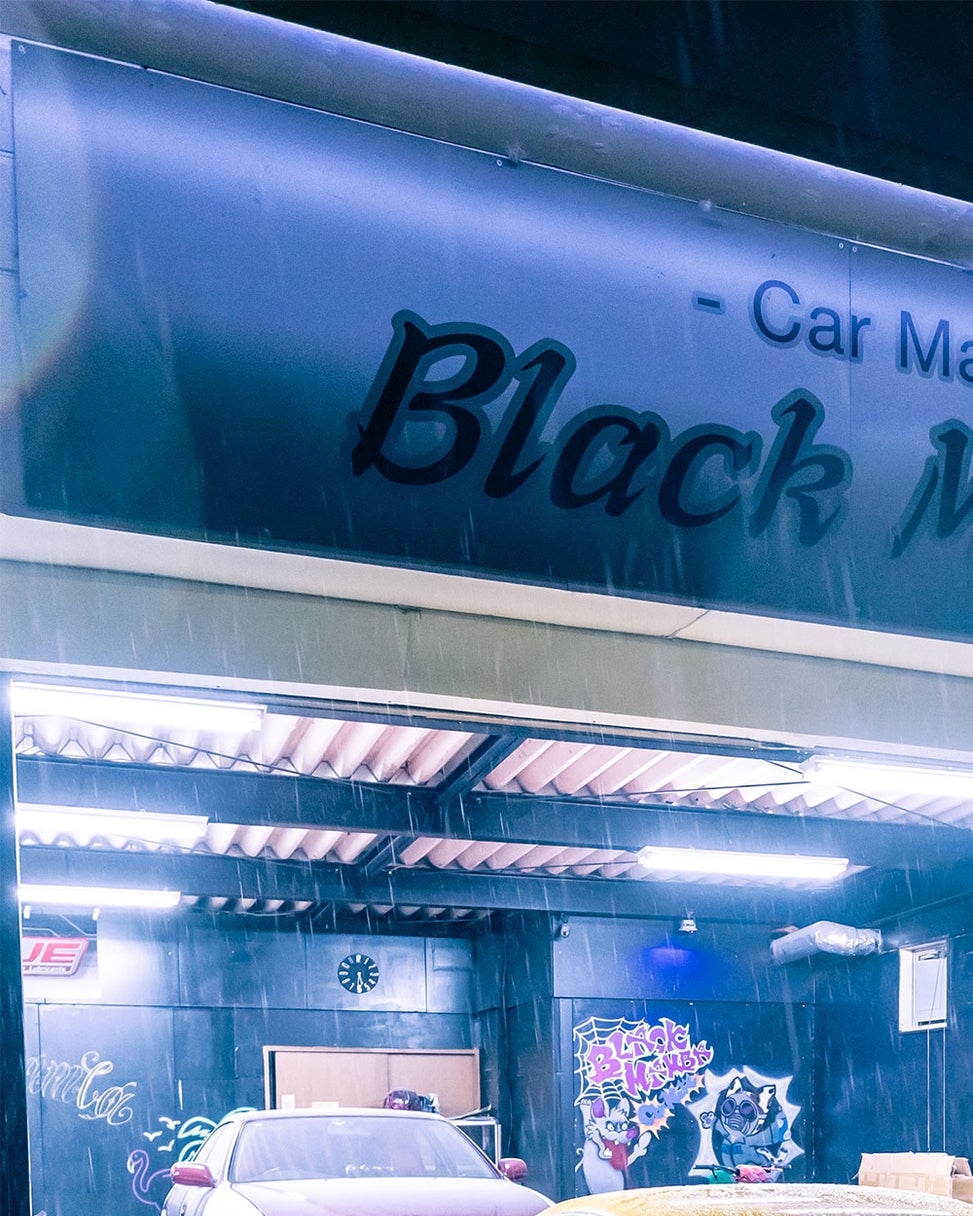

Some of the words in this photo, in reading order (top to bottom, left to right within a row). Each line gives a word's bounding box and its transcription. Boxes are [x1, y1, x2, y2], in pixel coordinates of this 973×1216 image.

[752, 278, 872, 360] Car
[351, 318, 850, 546] Black
[584, 1018, 690, 1084] BLACK
